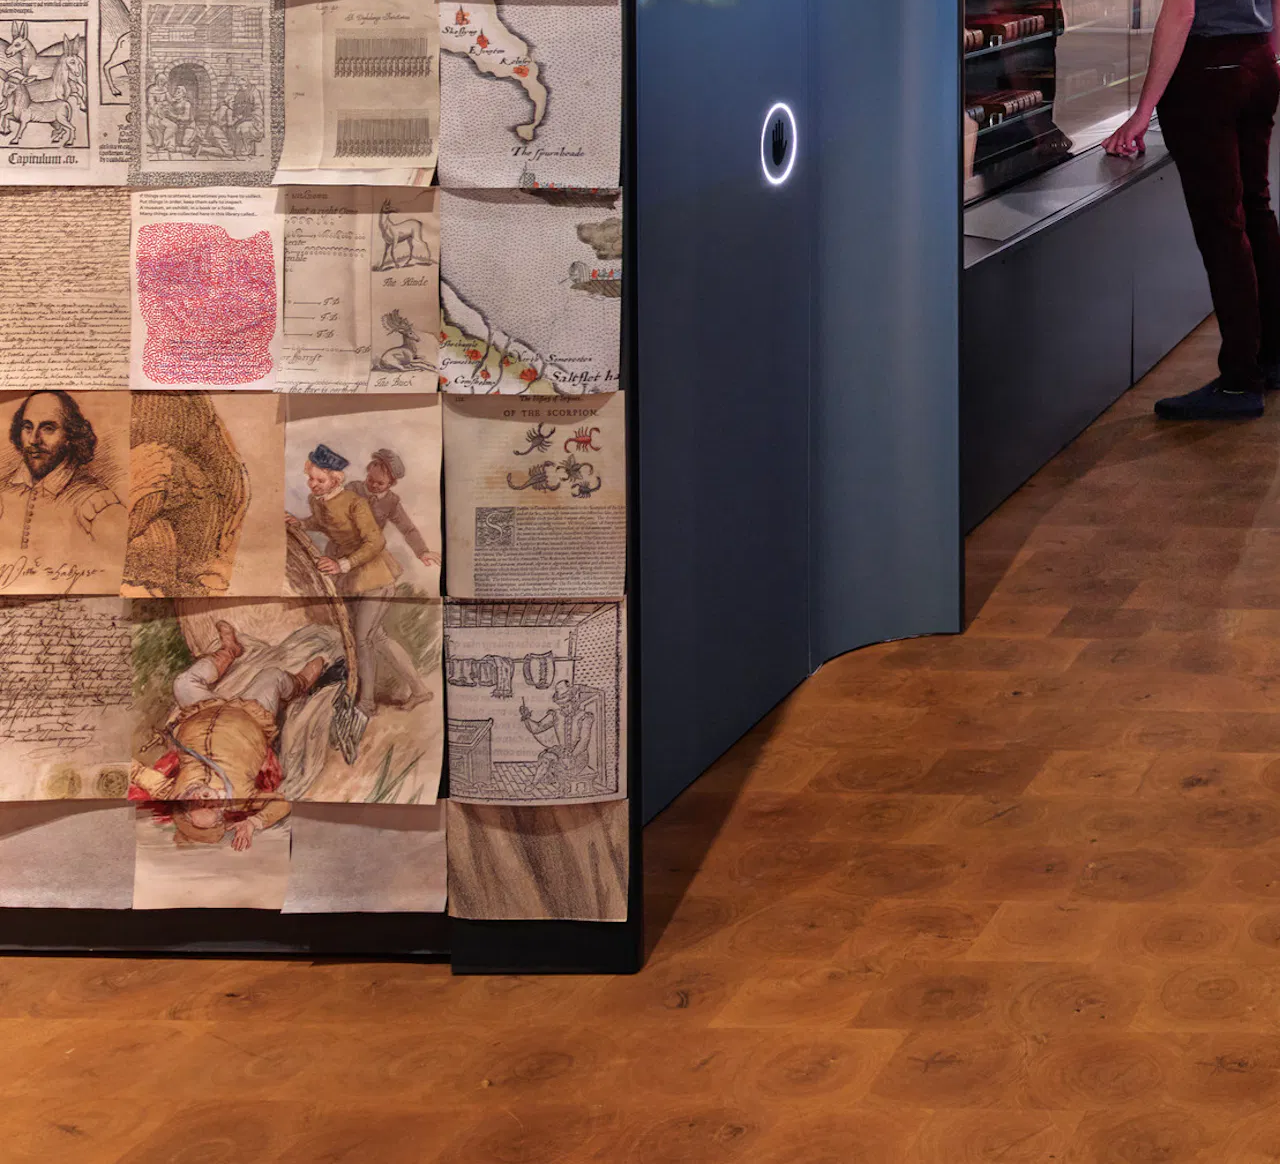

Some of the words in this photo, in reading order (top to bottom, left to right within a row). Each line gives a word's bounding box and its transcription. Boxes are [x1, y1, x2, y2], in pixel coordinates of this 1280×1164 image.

[511, 146, 532, 156] The
[503, 409, 516, 417] OF
[521, 409, 541, 417] THE
